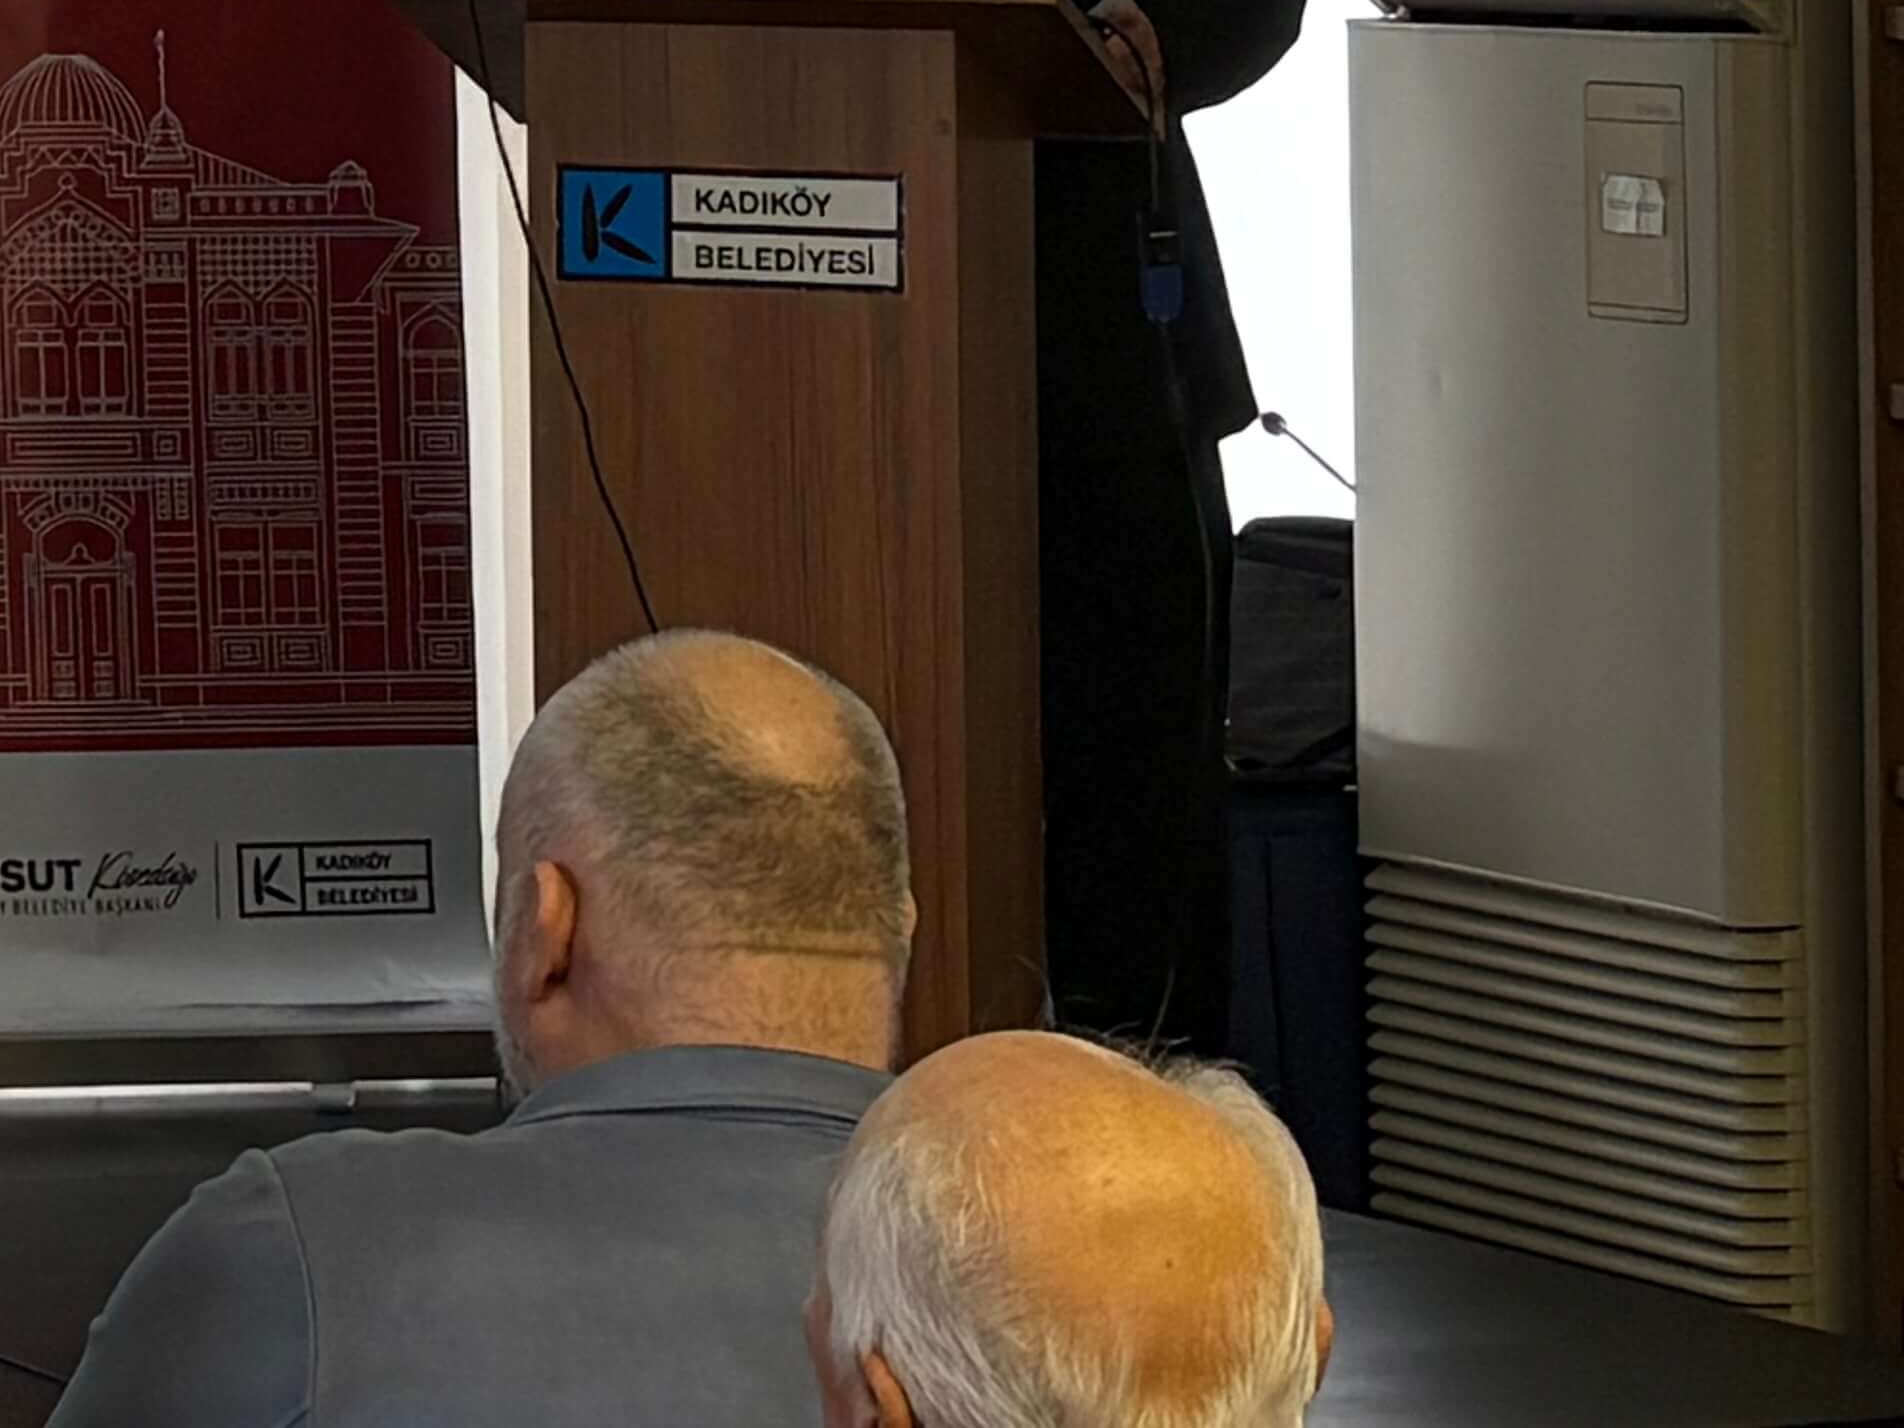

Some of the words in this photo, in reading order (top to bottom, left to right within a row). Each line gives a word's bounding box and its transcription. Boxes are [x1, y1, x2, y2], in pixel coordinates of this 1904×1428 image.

[694, 185, 832, 217] KADIKÖY
[694, 242, 875, 276] BELEDİYESİ
[315, 850, 392, 871] KADIKÖY
[317, 885, 418, 905] BELEDİYESİ
